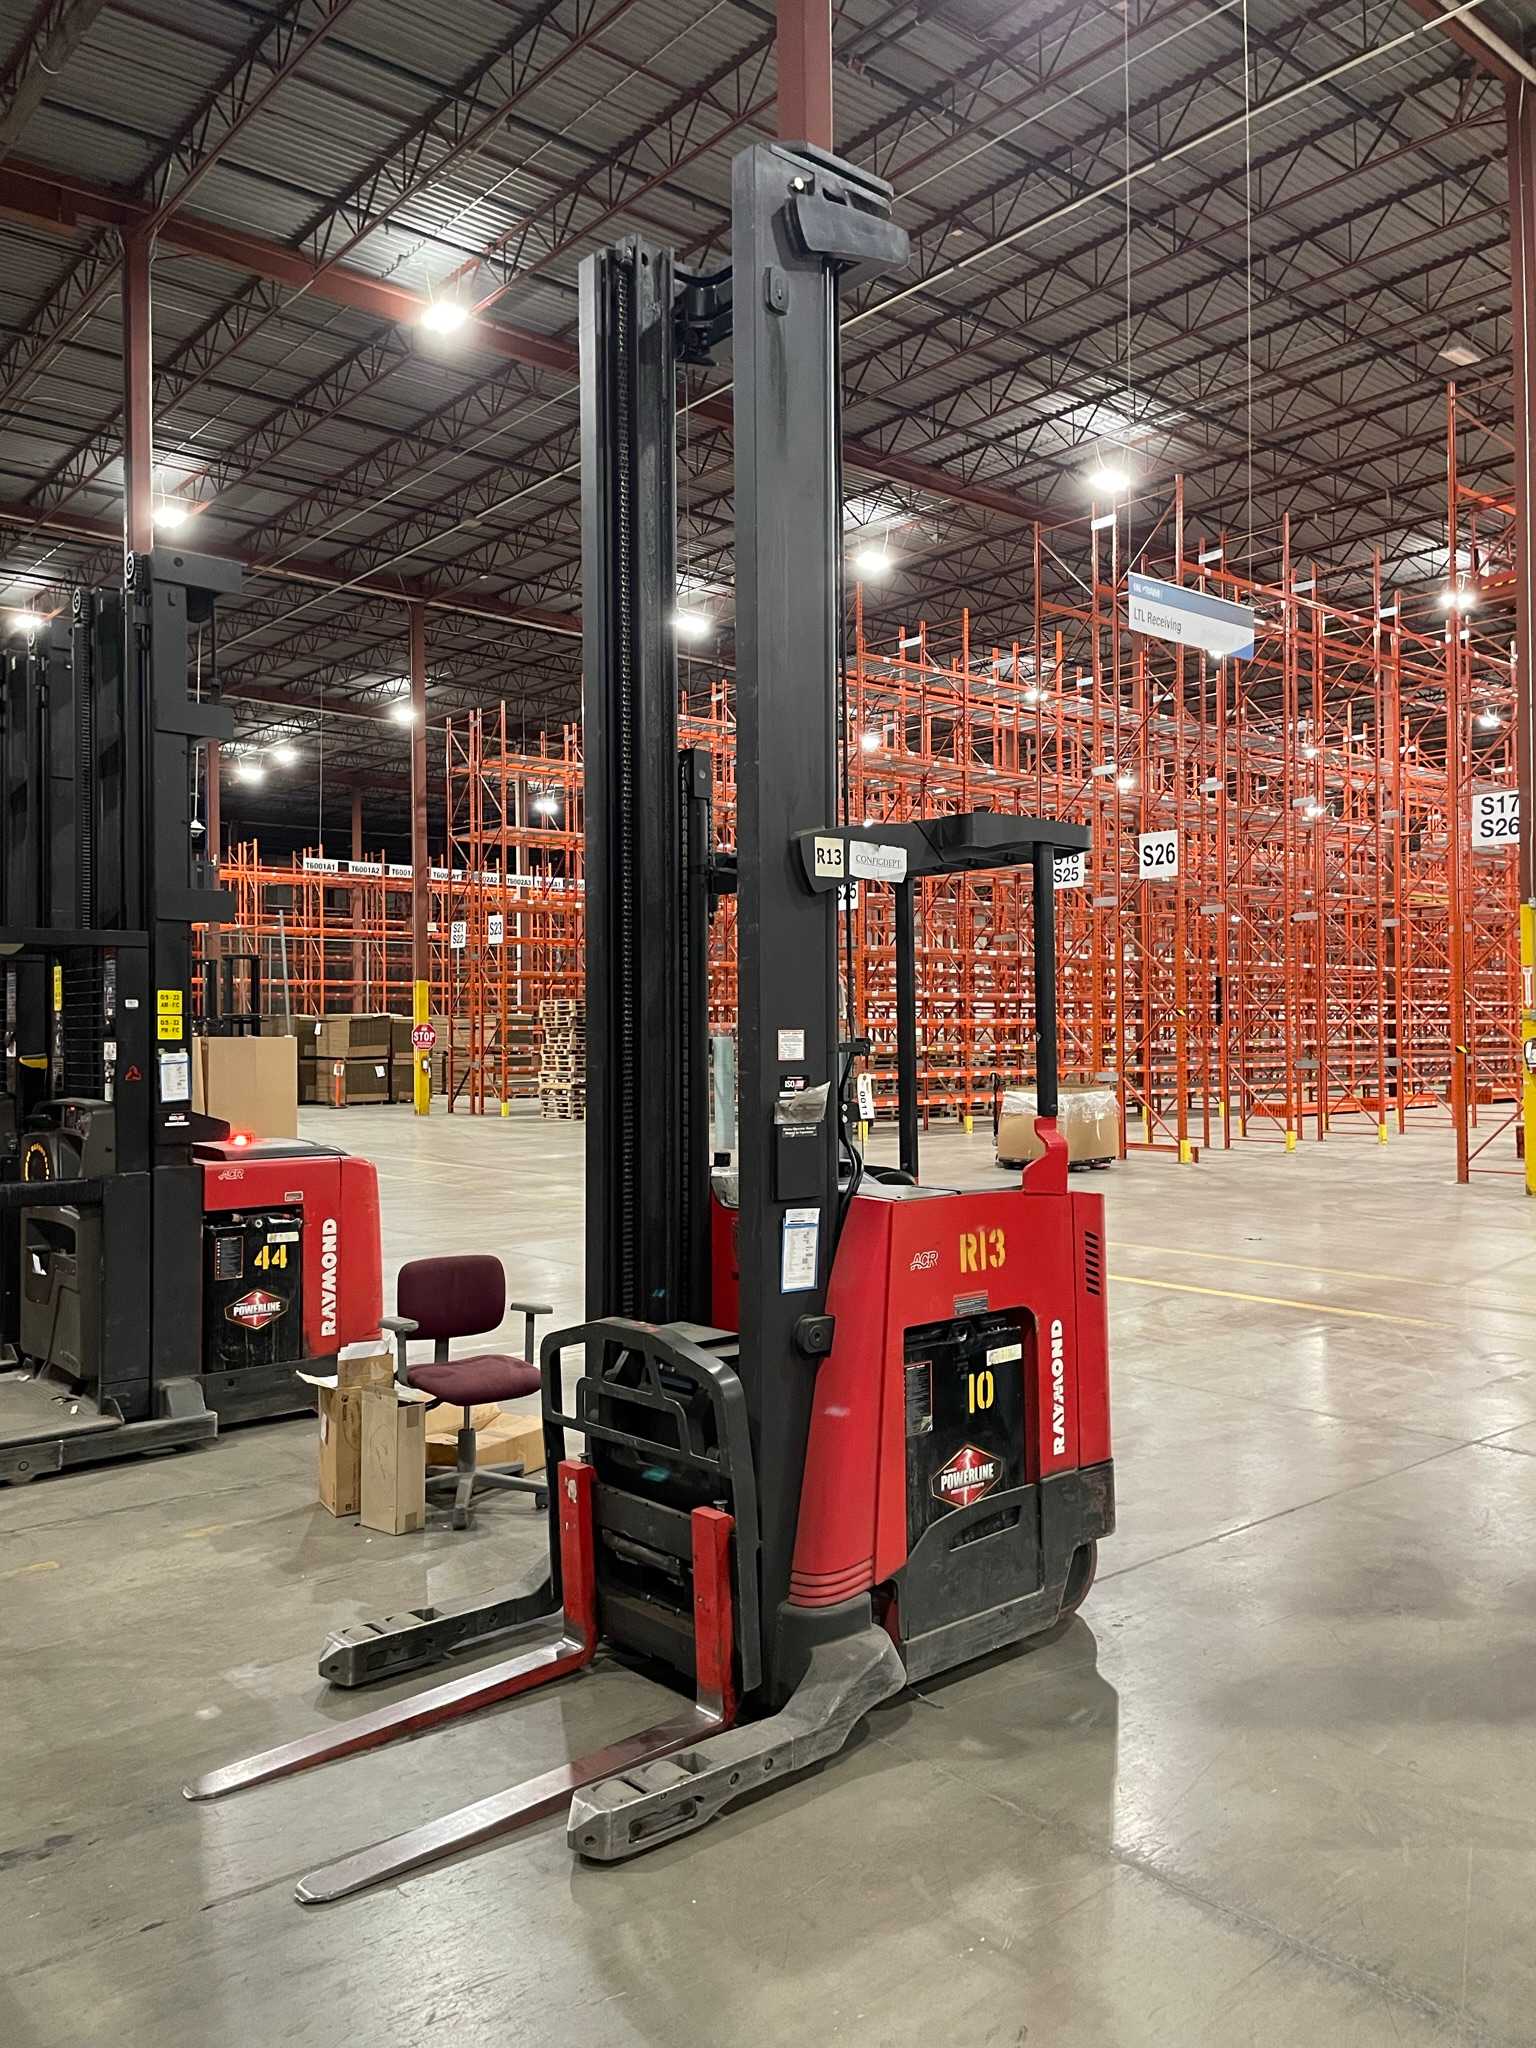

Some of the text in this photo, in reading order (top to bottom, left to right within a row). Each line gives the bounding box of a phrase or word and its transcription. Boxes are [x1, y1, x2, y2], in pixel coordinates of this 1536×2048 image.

[1134, 608, 1182, 634] LTL Receiving
[1481, 794, 1520, 815] S17
[1480, 816, 1520, 838] S26
[817, 848, 842, 865] R13
[1143, 842, 1175, 866] S26
[306, 862, 335, 871] T6001A1
[352, 865, 380, 874] T6001A2
[392, 868, 413, 876] T6001
[1053, 867, 1079, 882] S25
[453, 924, 463, 933] S21
[453, 934, 464, 944] S22
[490, 922, 502, 935] S23
[413, 1031, 435, 1042] STOP
[254, 1244, 287, 1270] 44
[910, 1250, 938, 1271] ACR
[960, 1228, 1006, 1273] R13
[321, 1218, 337, 1337] RAYMOND
[233, 1301, 281, 1317] POWERLINE
[968, 1370, 994, 1414] 10
[1050, 1319, 1065, 1456] RAYMOND
[940, 1462, 994, 1492] POWERLINE
